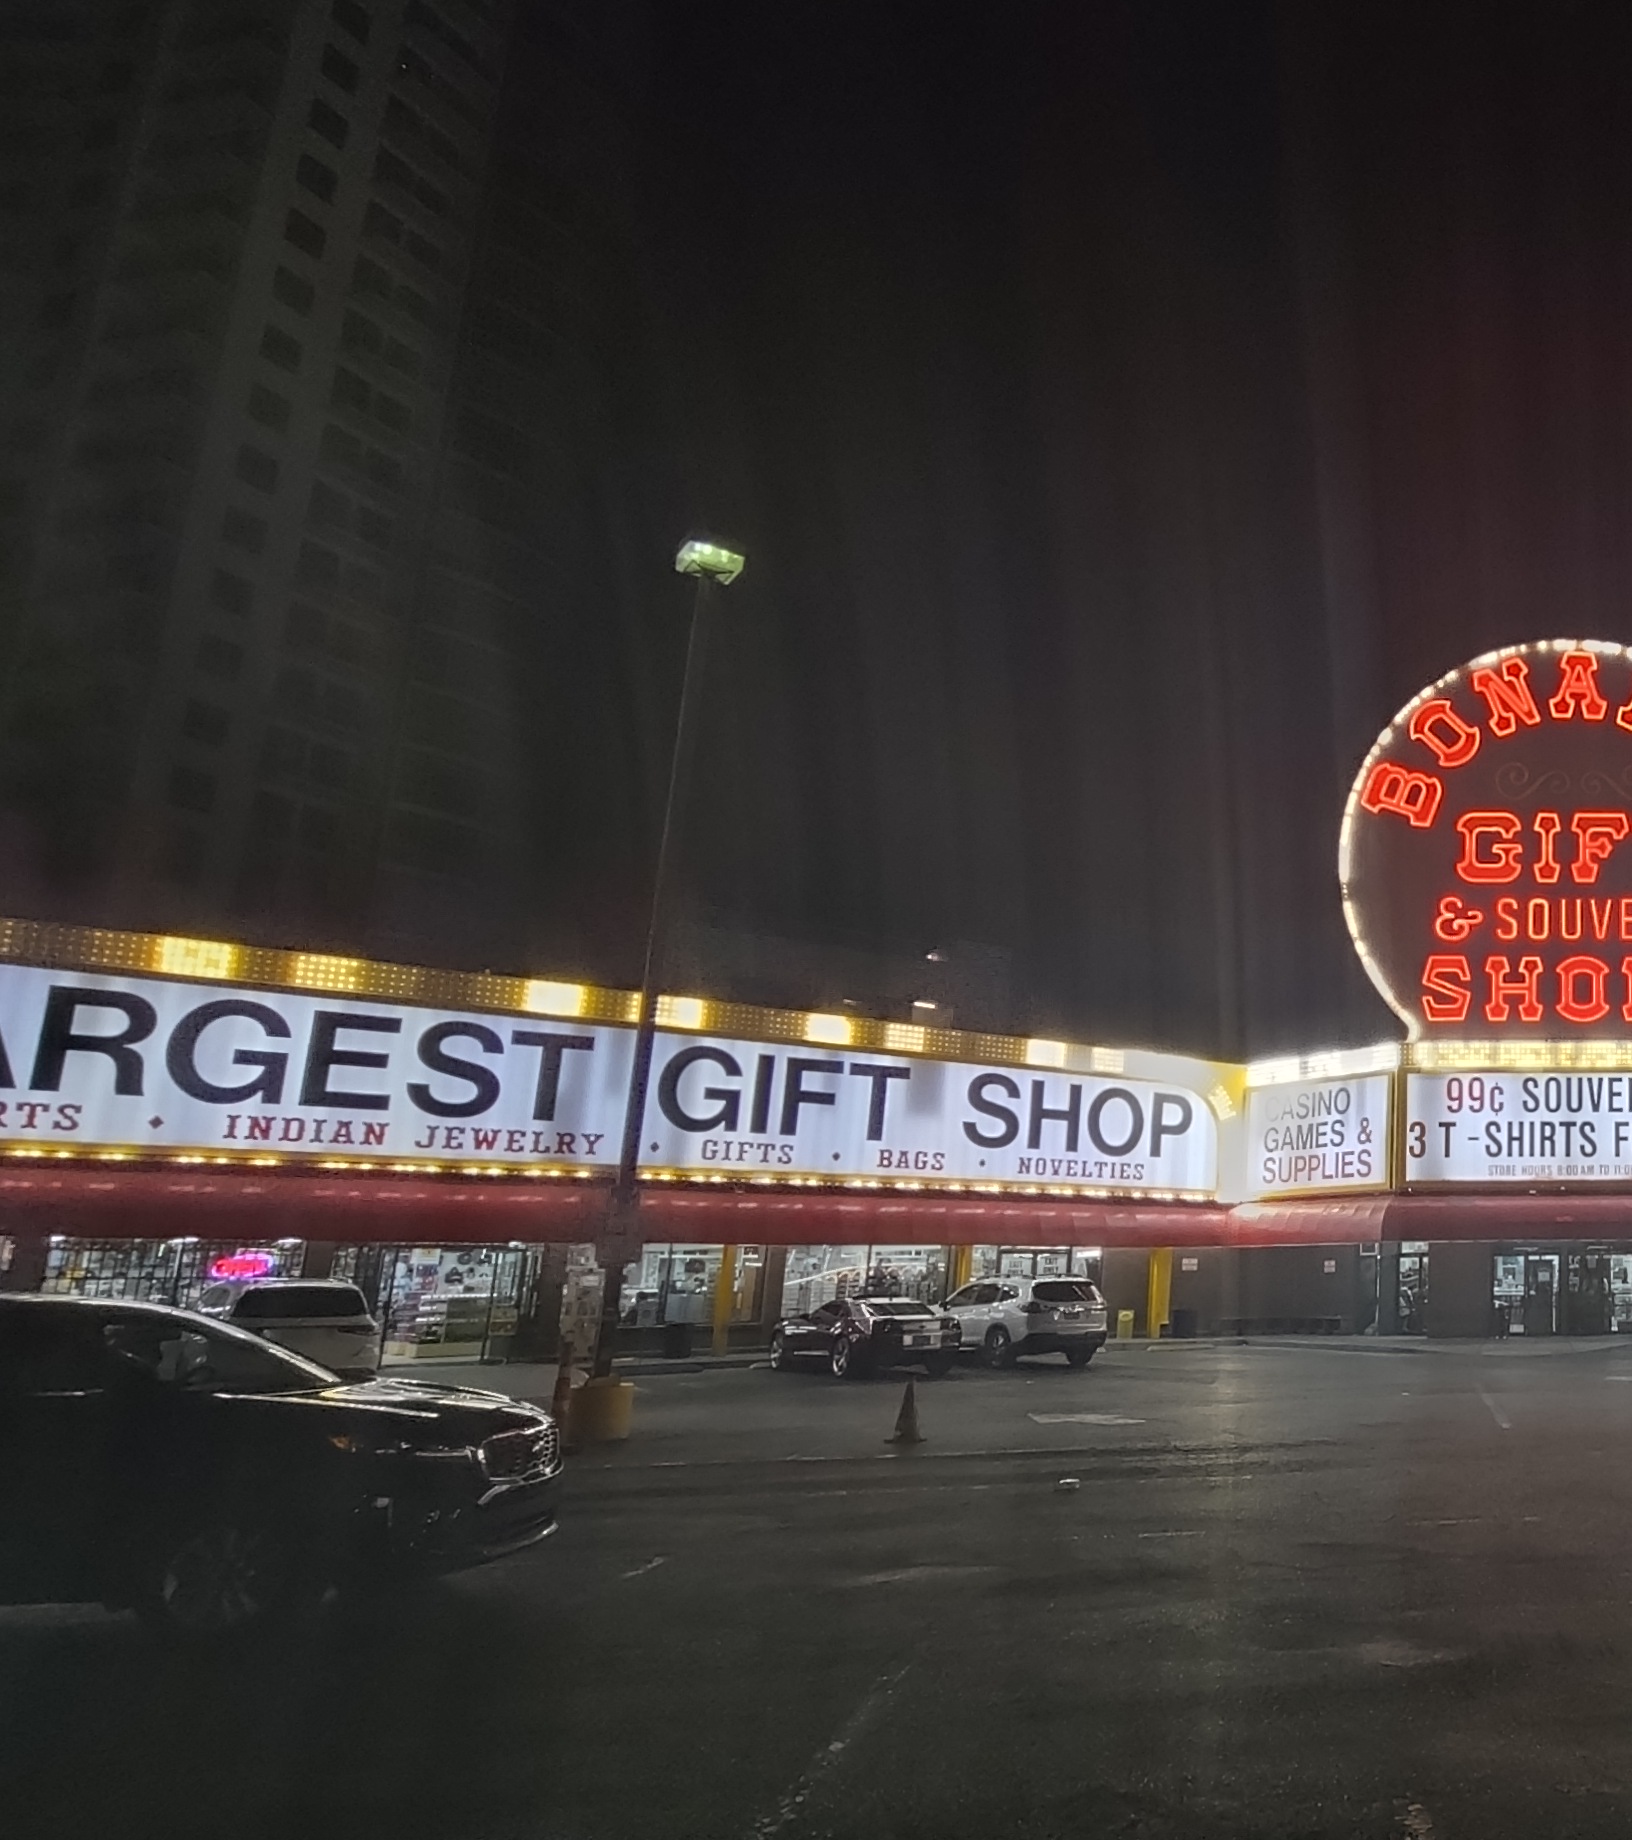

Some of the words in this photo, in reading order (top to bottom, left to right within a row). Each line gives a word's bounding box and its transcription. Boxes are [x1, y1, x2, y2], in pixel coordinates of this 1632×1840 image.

[1435, 896, 1483, 941] &
[0, 985, 595, 1121] RGEST
[658, 1046, 911, 1141] GIFT
[962, 1072, 1193, 1158] SHOP
[1265, 1087, 1350, 1122] CASINO
[0, 1101, 82, 1131] TS
[223, 1115, 389, 1146] INDIAN
[415, 1126, 604, 1156] JEWELRY
[702, 1139, 794, 1164] GIFTS
[877, 1149, 945, 1171] BAGS
[1018, 1157, 1144, 1181] NOVELTIES
[1264, 1119, 1345, 1153] GAMES
[1358, 1117, 1372, 1145] &
[1409, 1121, 1426, 1158] 3
[1262, 1149, 1372, 1184] SUPPLIES
[1488, 1164, 1516, 1176] STORE
[1521, 1164, 1553, 1176] HOURS
